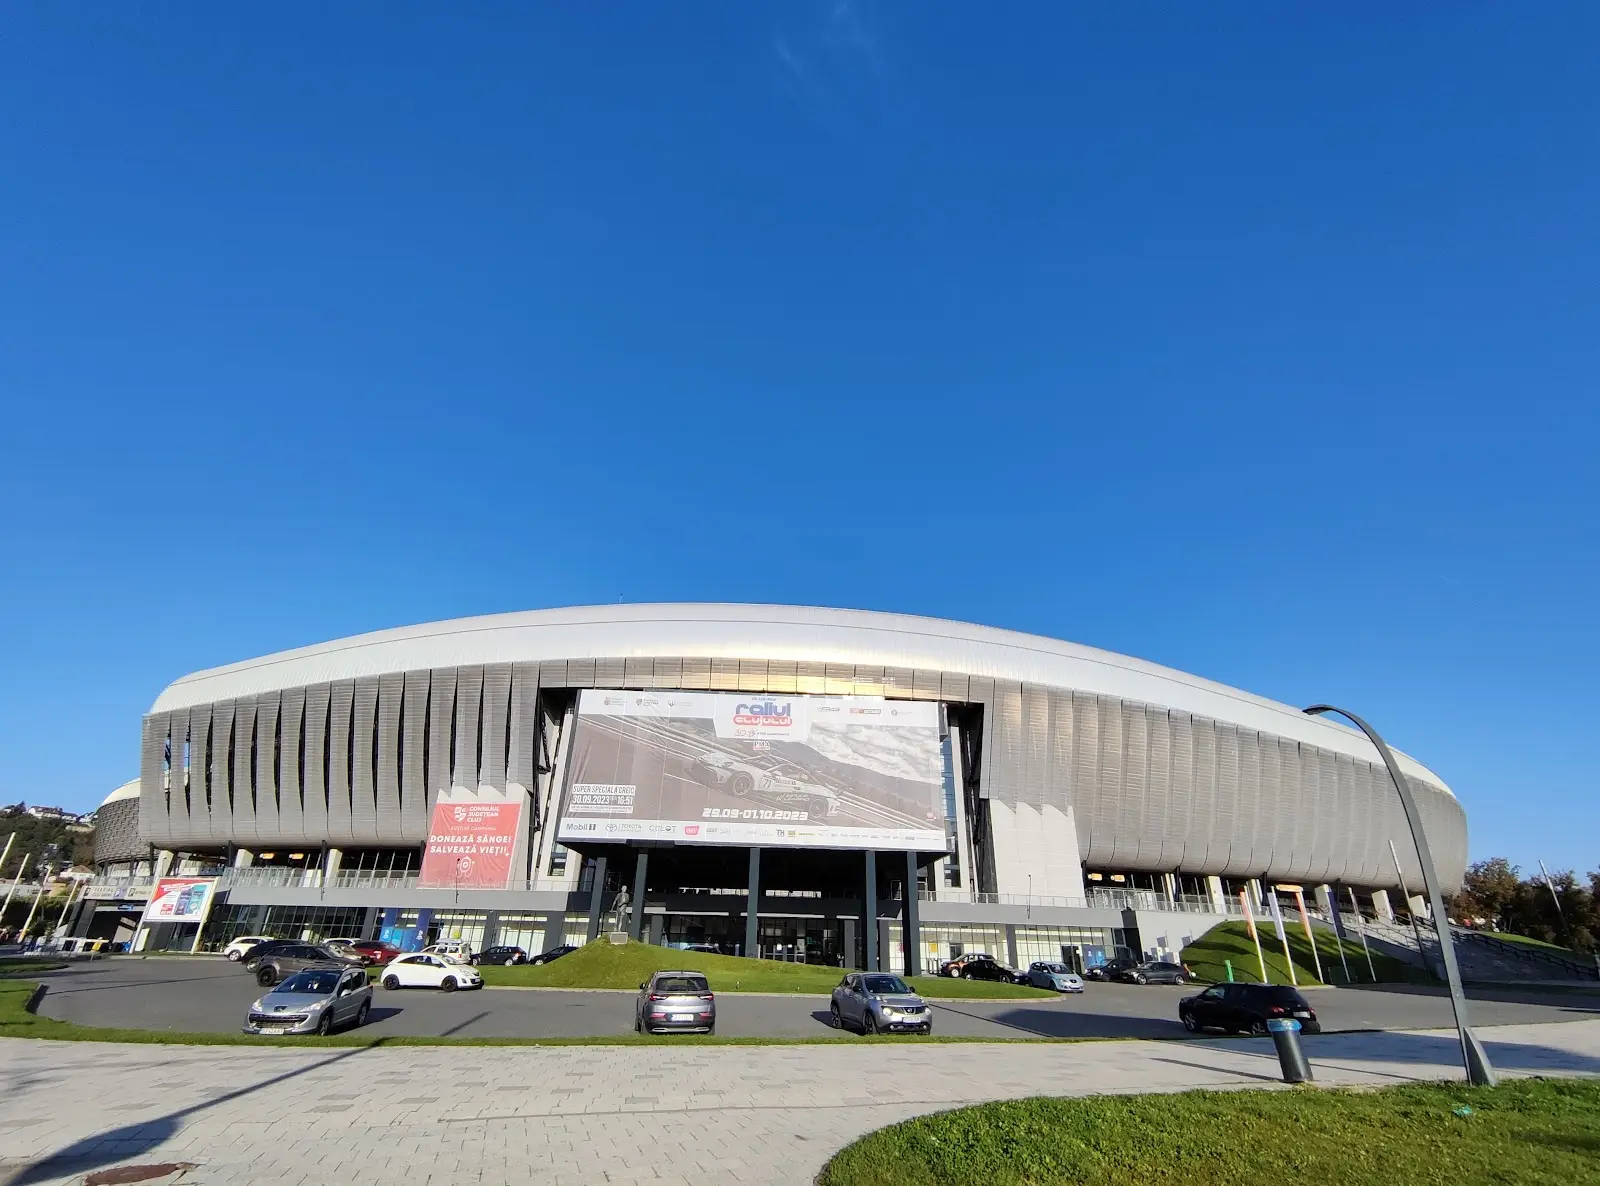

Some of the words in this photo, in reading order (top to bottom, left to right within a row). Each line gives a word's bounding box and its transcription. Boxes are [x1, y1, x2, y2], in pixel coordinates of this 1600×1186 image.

[573, 785, 591, 793] SUPER
[573, 795, 610, 805] 30.09.2023
[703, 808, 808, 820] 29.09-01.10.2023
[566, 823, 588, 831] Mobil
[430, 833, 474, 843] DONEAZĂ
[430, 845, 477, 854] SALVEAZĂ
